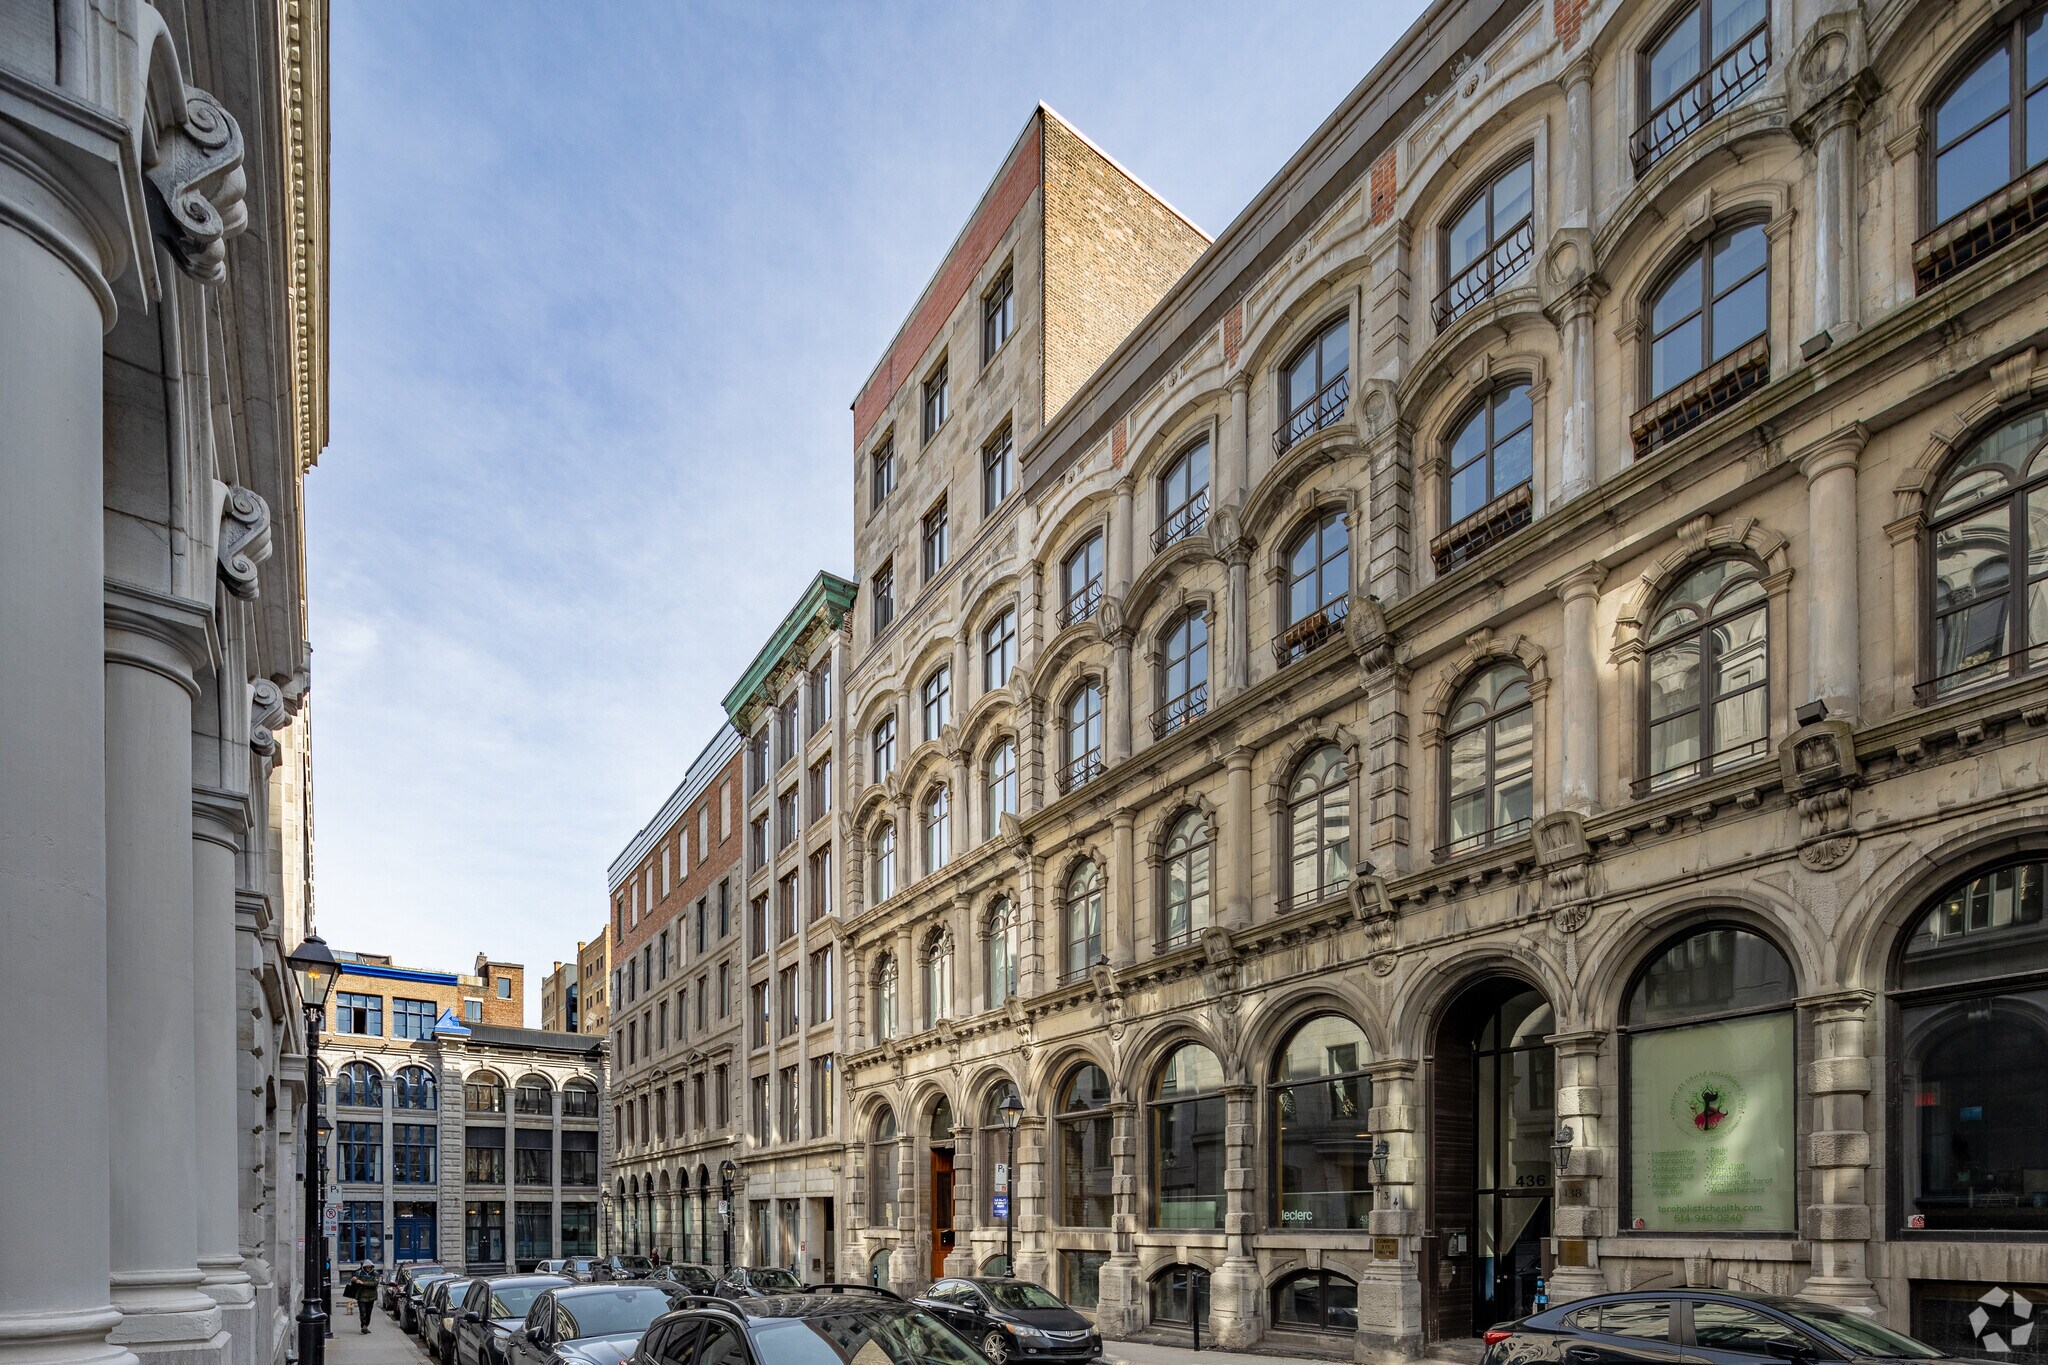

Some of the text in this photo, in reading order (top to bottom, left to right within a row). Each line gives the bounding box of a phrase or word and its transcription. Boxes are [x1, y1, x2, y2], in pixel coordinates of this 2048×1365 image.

[1651, 1149, 1696, 1158] Homéopathie
[1651, 1158, 1697, 1166] Naturopathie
[1651, 1165, 1694, 1173] Ostéopathie
[1516, 1175, 1546, 1187] 436
[1561, 1188, 1582, 1198] 438
[1658, 1203, 1763, 1213] toroholistichealth.com
[1281, 1209, 1313, 1221] leclerc
[1674, 1214, 1743, 1222] 514-940-0240
